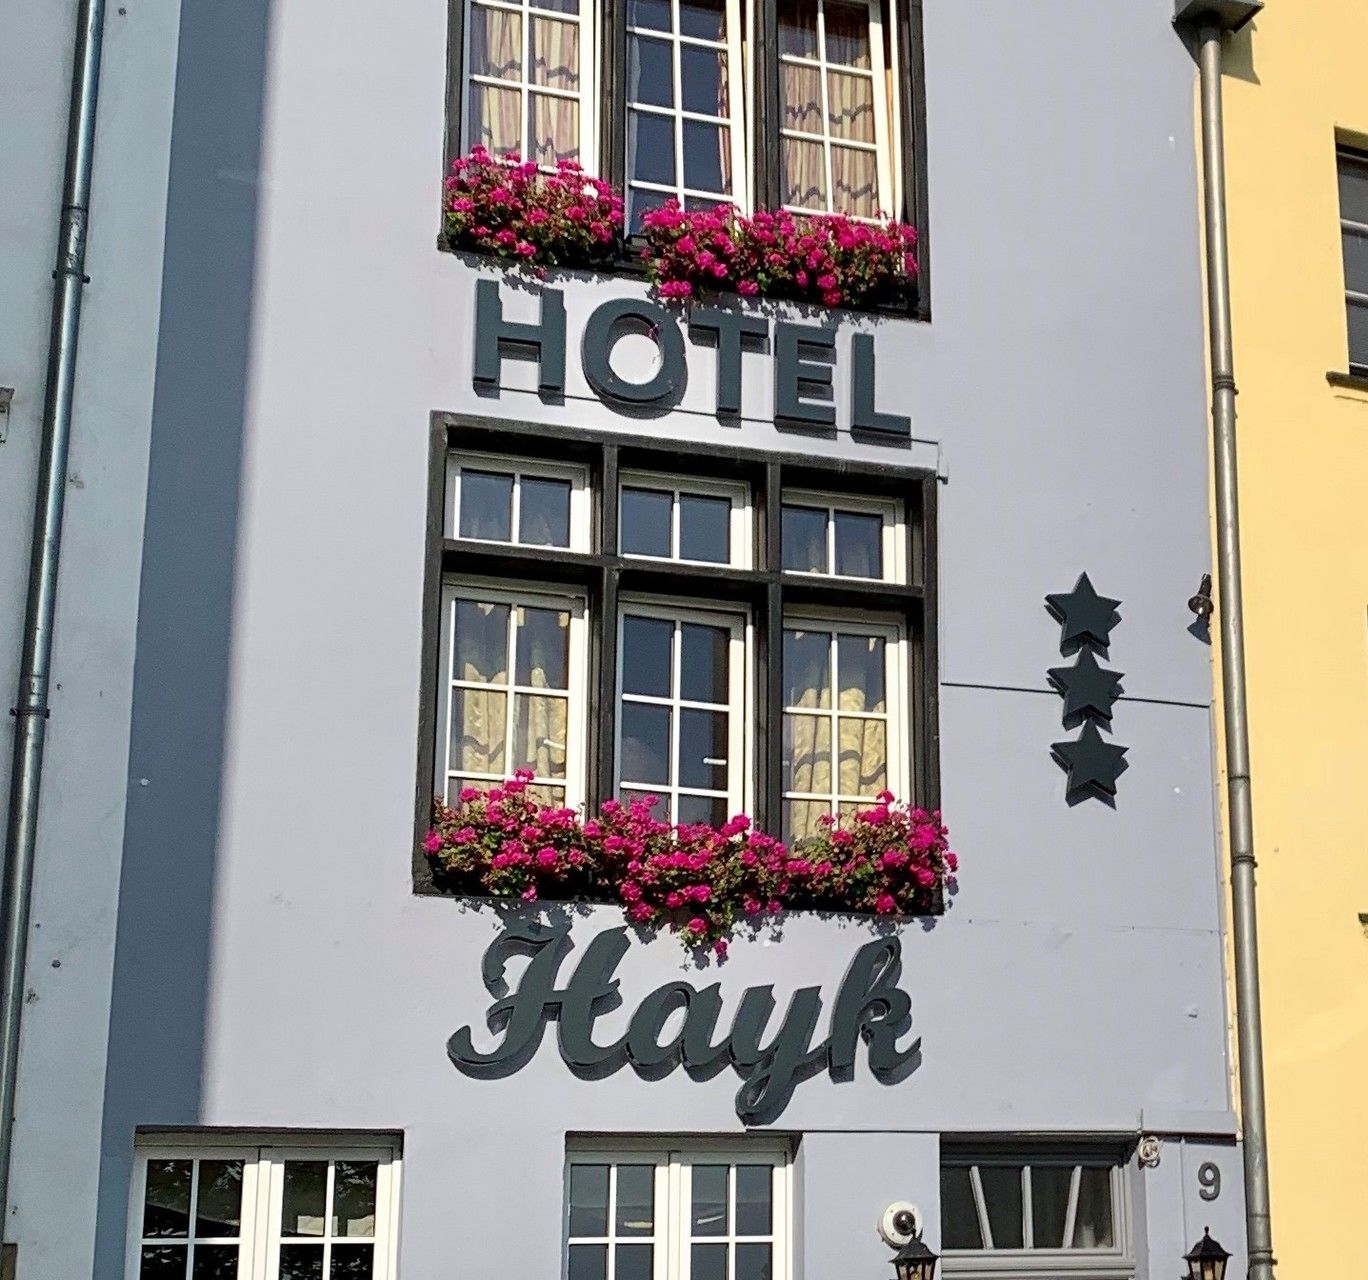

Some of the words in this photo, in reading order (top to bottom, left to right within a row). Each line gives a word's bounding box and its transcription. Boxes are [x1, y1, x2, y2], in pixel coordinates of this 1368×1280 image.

[472, 278, 912, 440] HOTEL
[446, 923, 922, 1127] Hayk
[1197, 1161, 1222, 1202] 9
